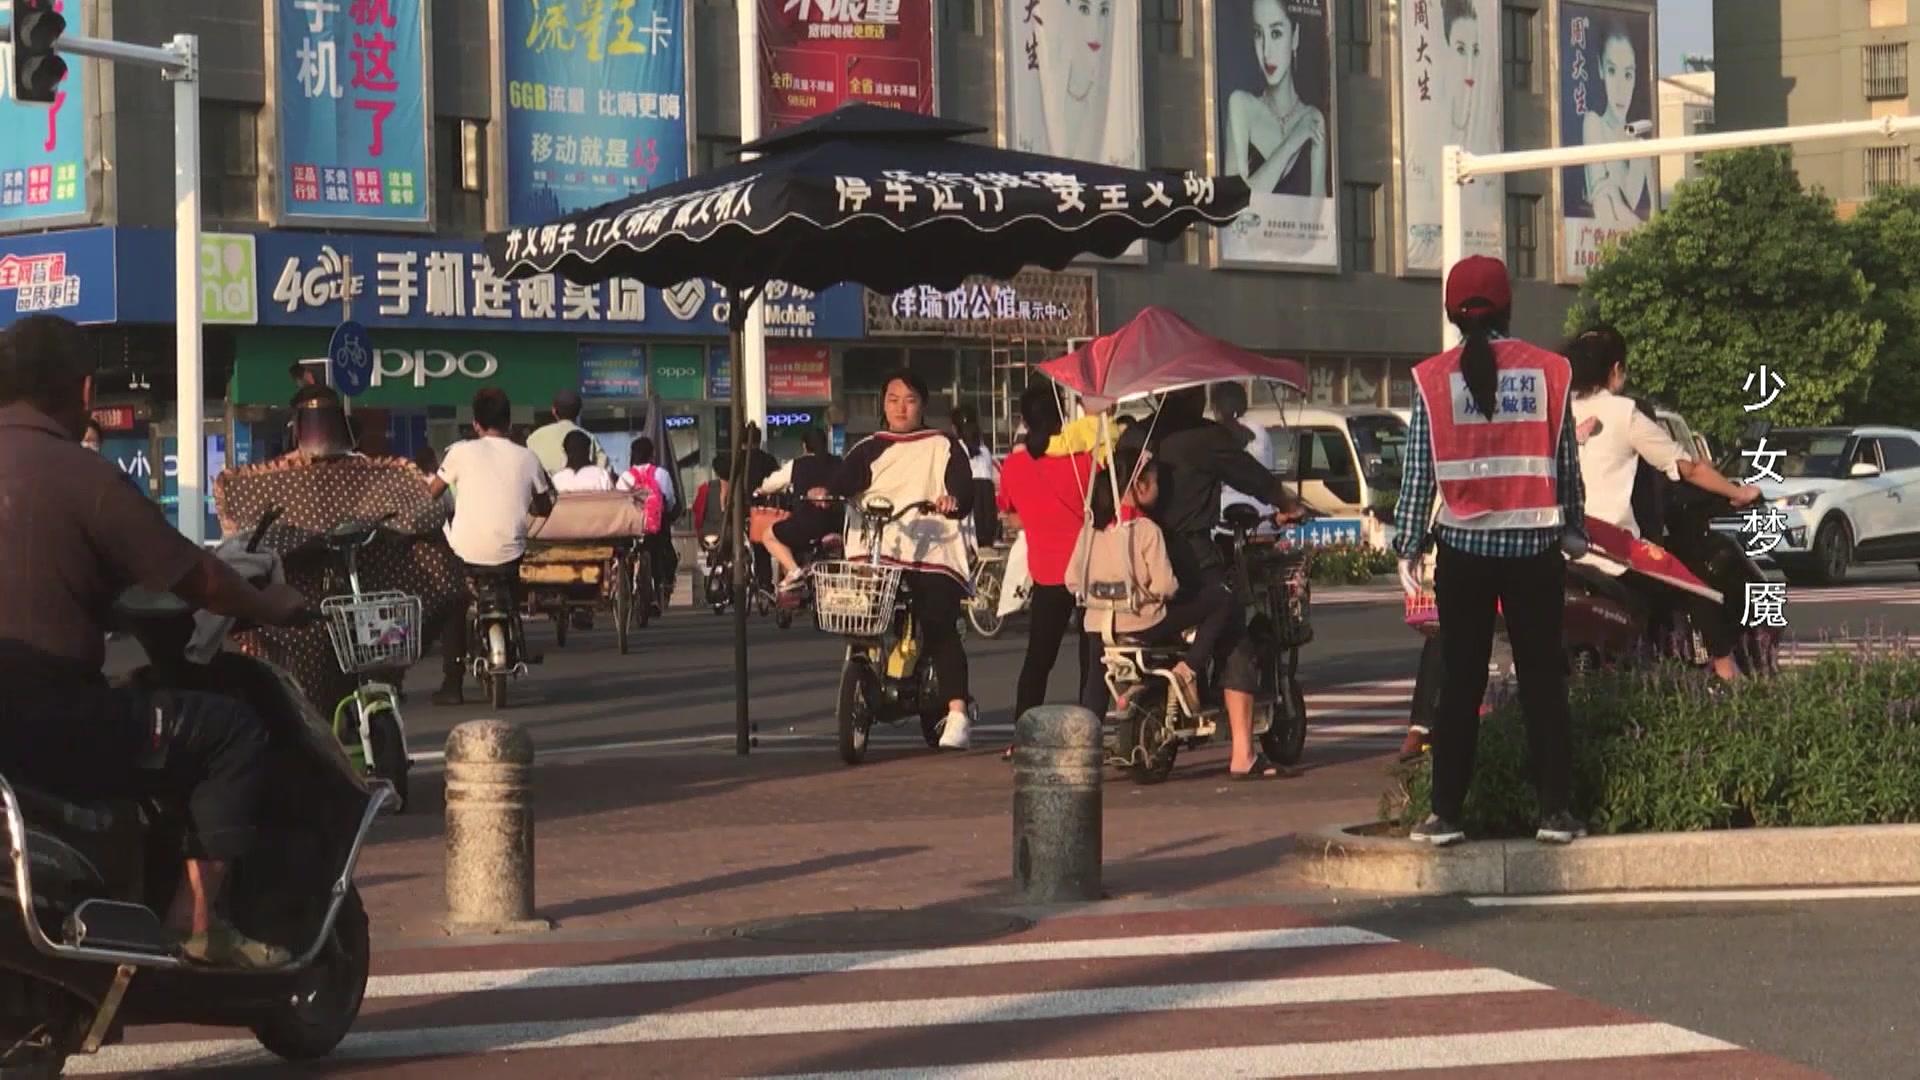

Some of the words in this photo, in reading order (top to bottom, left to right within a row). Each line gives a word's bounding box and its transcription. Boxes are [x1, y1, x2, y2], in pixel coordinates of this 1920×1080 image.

[765, 303, 816, 326] Mobile
[369, 348, 498, 388] ppo
[656, 366, 696, 379] oppo
[1463, 395, 1537, 415] 从做起
